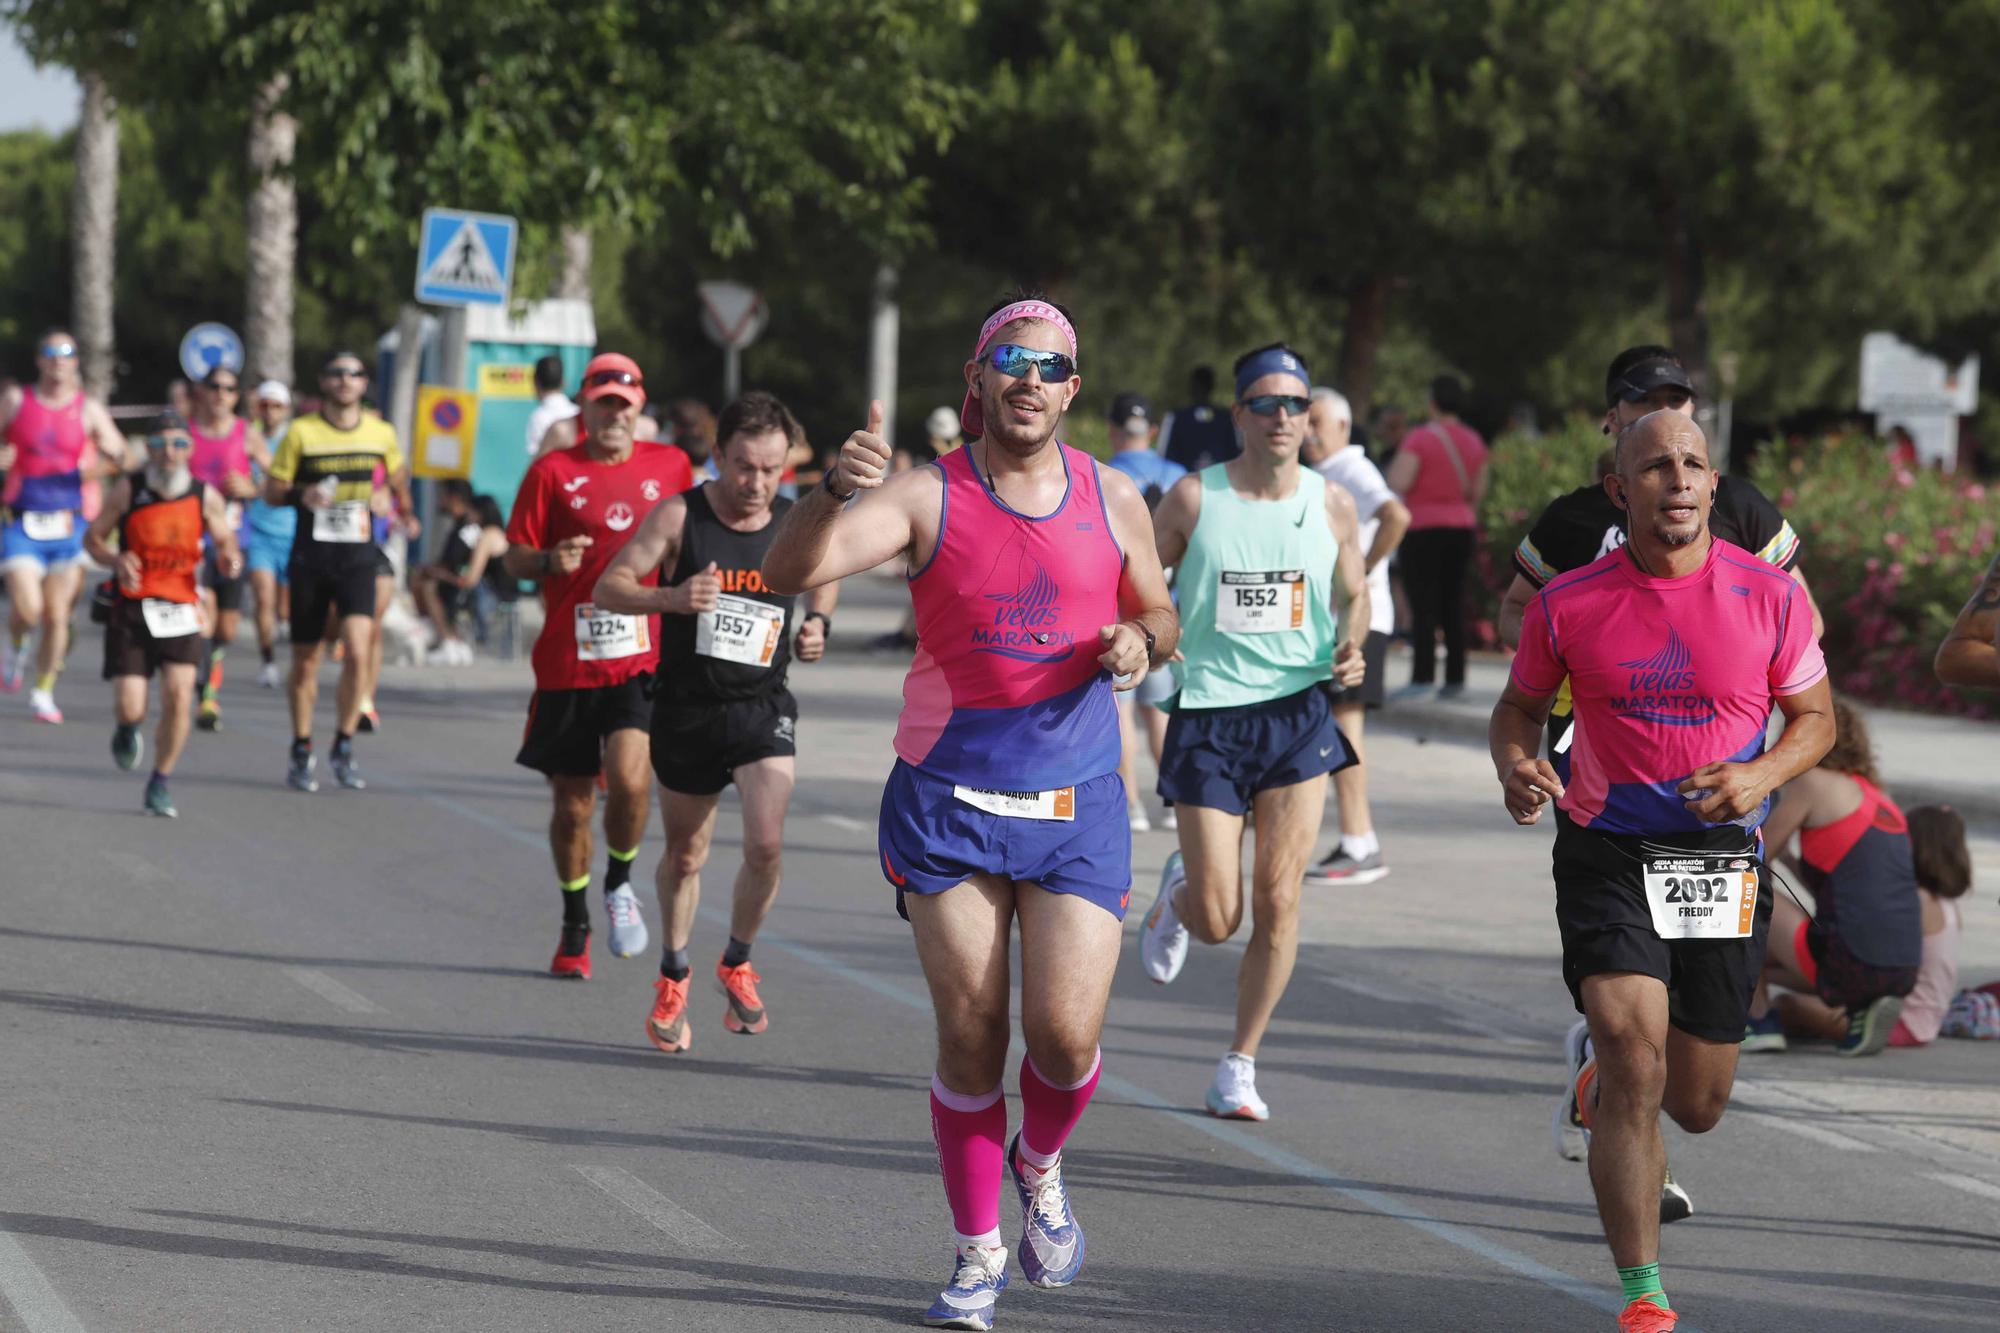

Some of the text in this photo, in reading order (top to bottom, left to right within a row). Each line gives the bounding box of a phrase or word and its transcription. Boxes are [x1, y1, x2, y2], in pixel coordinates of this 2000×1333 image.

[1235, 588, 1277, 606] 1552
[588, 619, 626, 637] 1224
[715, 613, 755, 637] 1557
[1630, 670, 1697, 695] velas
[1610, 695, 1715, 710] MARATON
[1664, 877, 1729, 903] 2092
[1744, 882, 1754, 900] BOX
[1678, 907, 1714, 917] FREDDY
